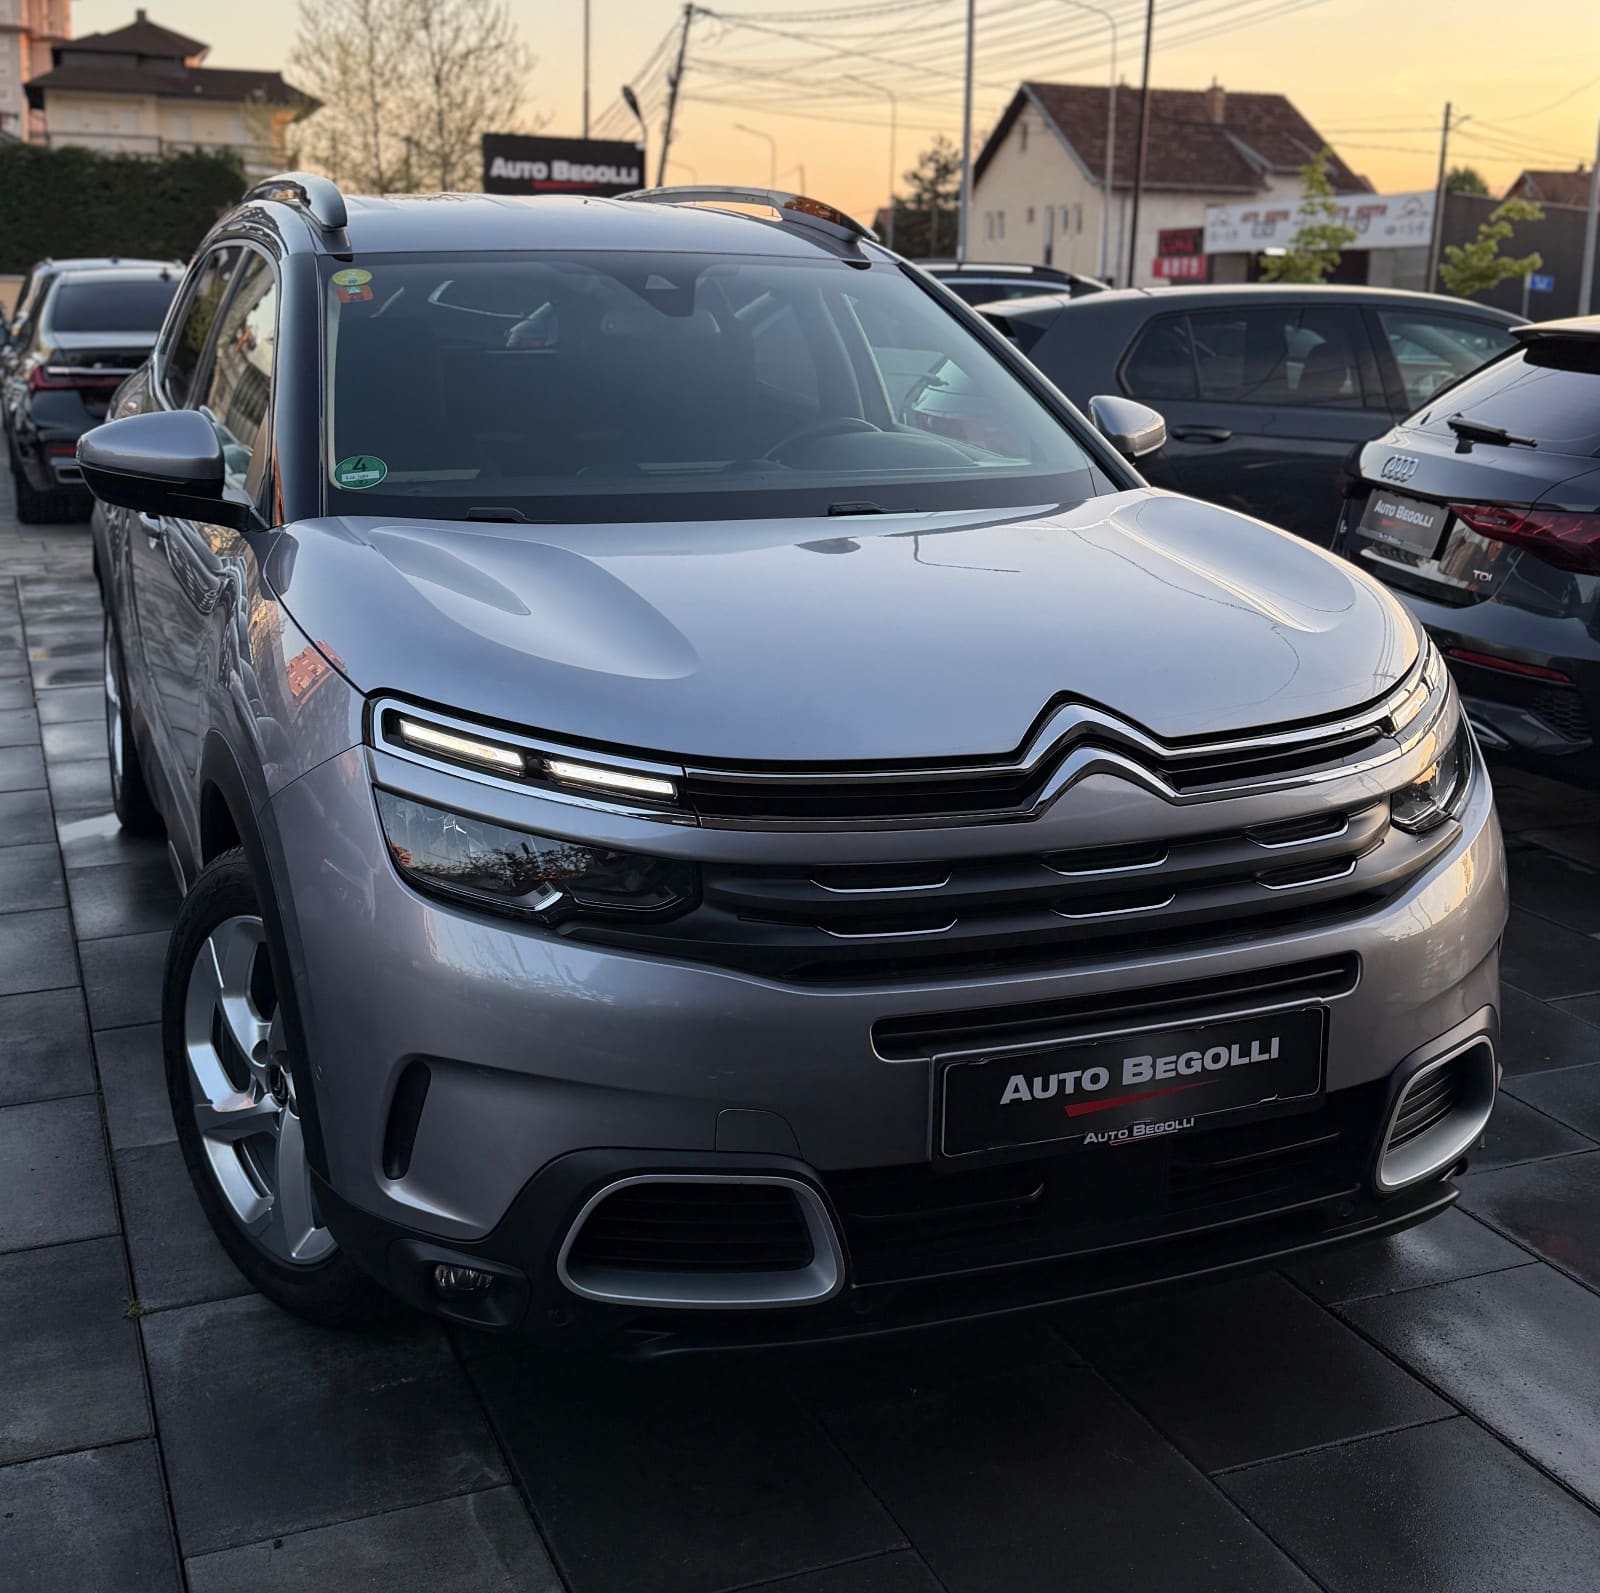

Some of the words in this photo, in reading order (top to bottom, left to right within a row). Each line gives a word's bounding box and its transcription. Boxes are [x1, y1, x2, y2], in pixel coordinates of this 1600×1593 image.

[490, 156, 548, 180] AUTO
[1374, 499, 1396, 516] AUTO
[1473, 569, 1493, 582] TDI
[1000, 1067, 1110, 1105] AUTO
[1122, 1036, 1280, 1086] BEGOLLI
[1083, 1129, 1129, 1145] AUTO
[1133, 1117, 1196, 1138] BEGOLLI
